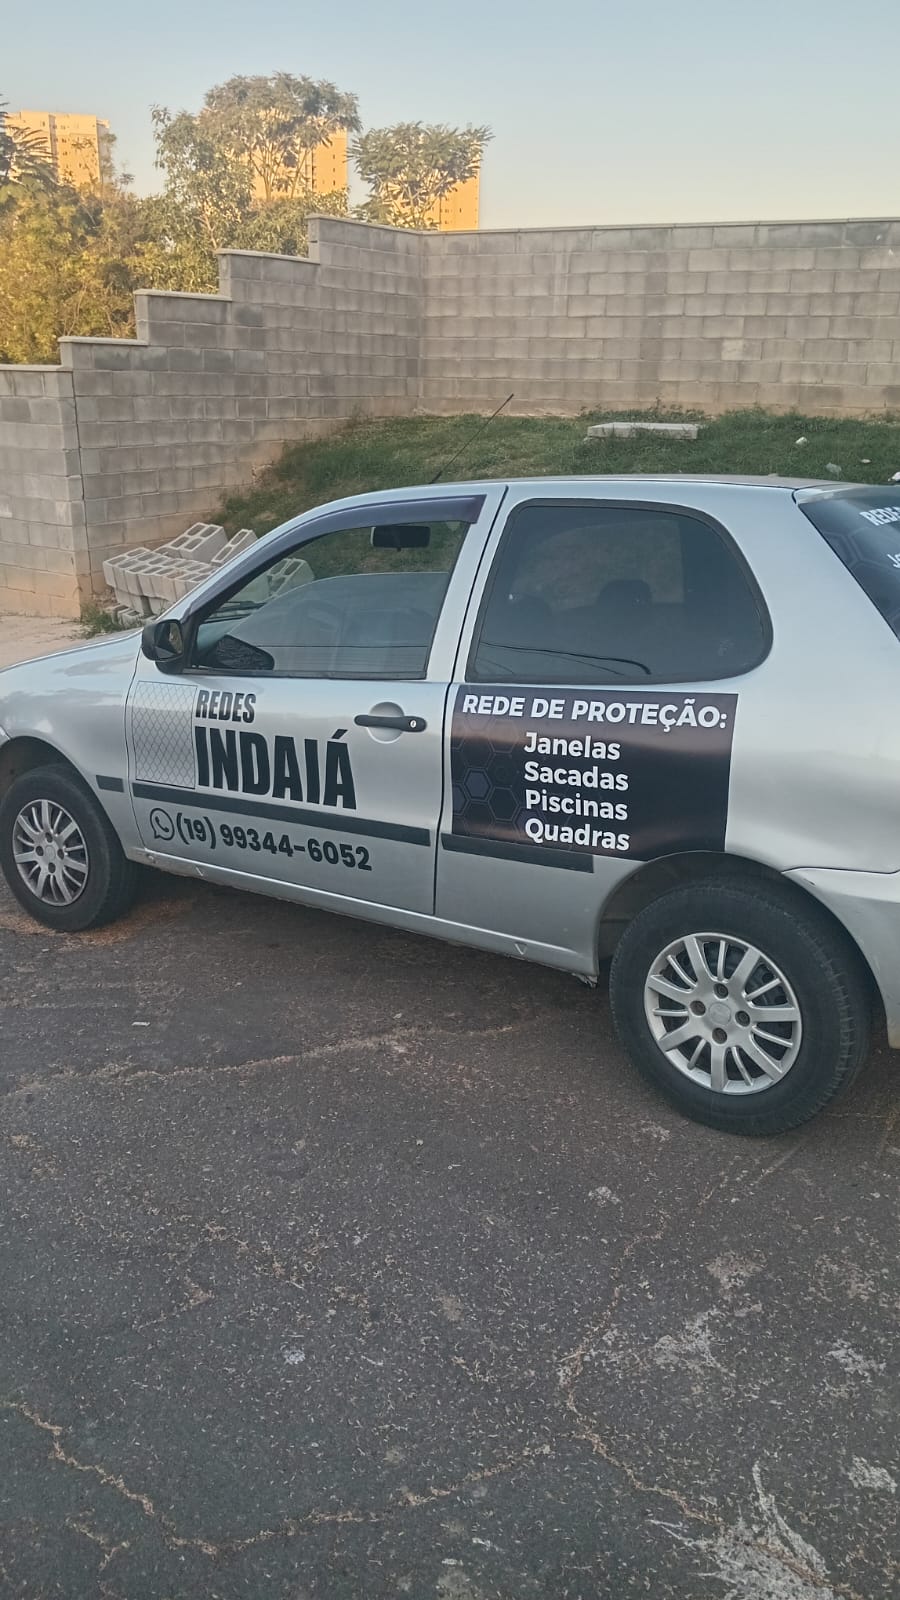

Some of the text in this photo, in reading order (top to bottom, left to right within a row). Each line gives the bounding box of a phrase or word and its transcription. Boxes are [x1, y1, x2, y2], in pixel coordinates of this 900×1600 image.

[195, 689, 257, 724] REDES
[462, 694, 728, 732] REDE DE PROTEÇÃO:
[523, 732, 622, 761] Janelas
[194, 726, 357, 810] INDAIÁ
[523, 761, 629, 792] Sacadas
[525, 789, 629, 821] Piscinas
[176, 812, 373, 871] (19) 99344-6052
[524, 818, 631, 852] Quadras
